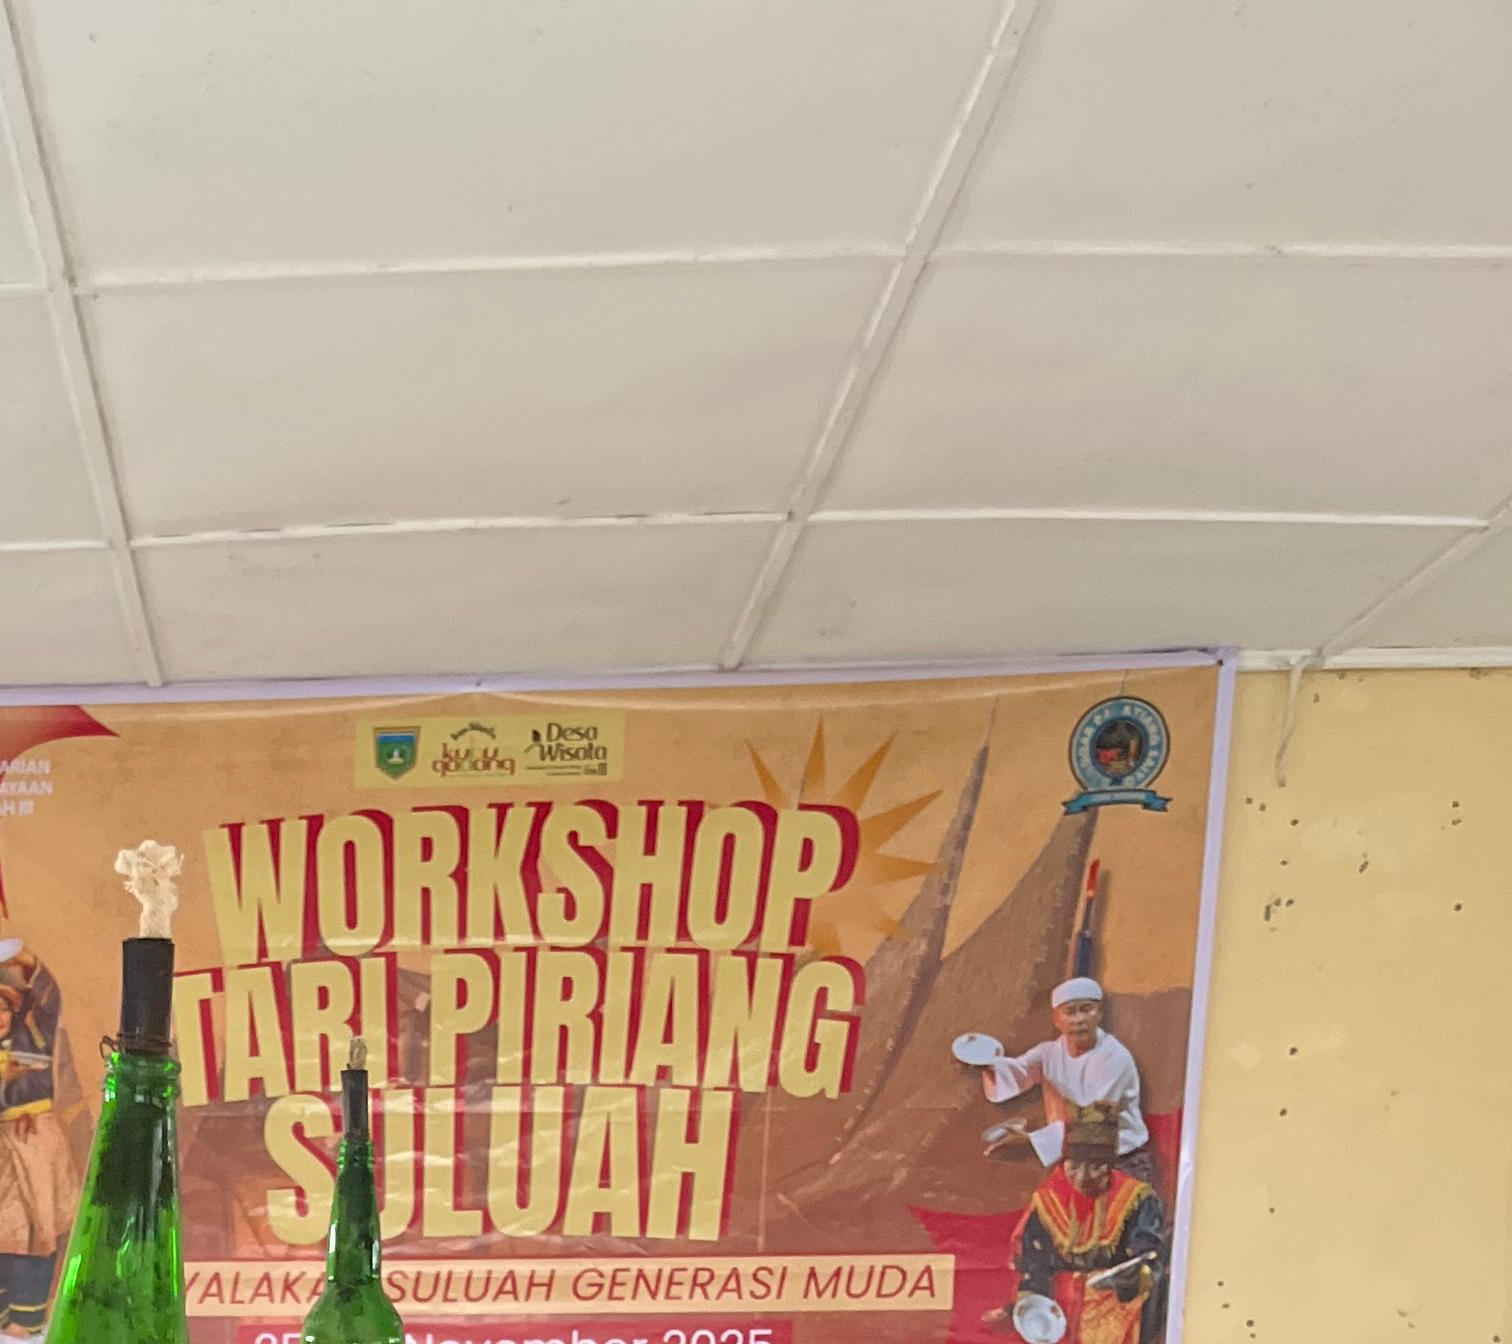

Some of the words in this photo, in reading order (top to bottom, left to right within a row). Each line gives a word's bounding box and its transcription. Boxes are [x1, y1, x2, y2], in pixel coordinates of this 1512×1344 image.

[547, 722, 598, 742] Desa
[537, 743, 607, 761] Wisata
[202, 802, 856, 966] WORKSHOP
[172, 957, 389, 1107] TARI
[429, 948, 858, 1100] PIRIANG
[386, 1269, 556, 1304] SULUAH
[572, 1266, 788, 1302] GENERASI
[803, 1265, 937, 1300] MUDA
